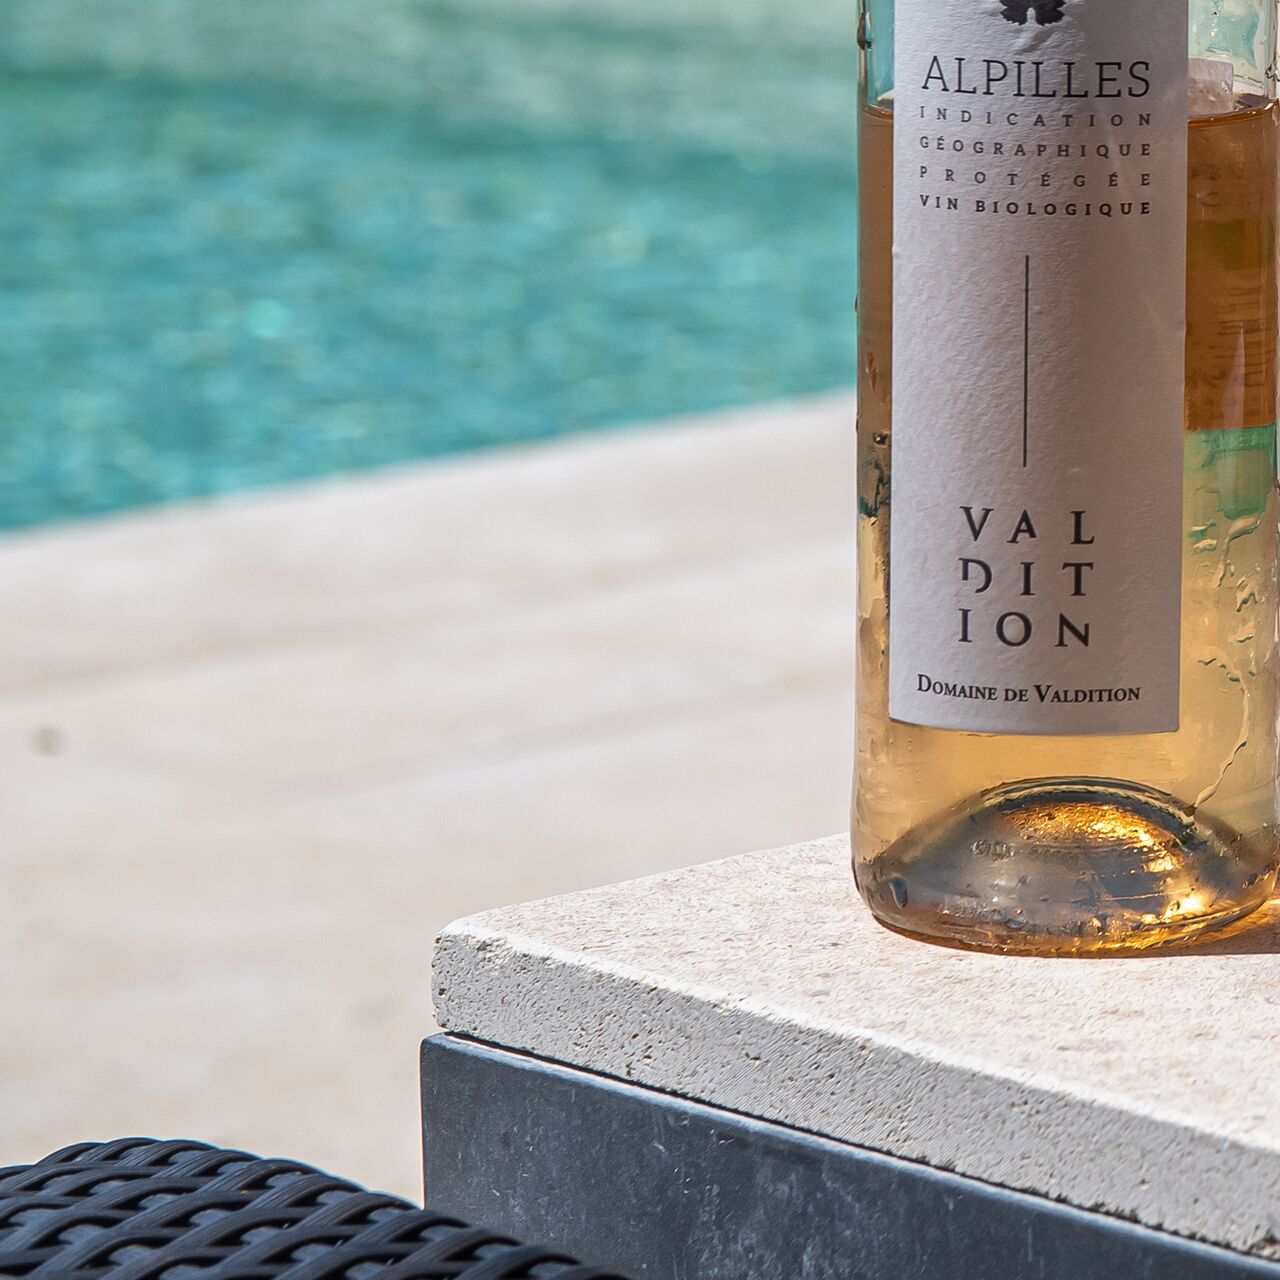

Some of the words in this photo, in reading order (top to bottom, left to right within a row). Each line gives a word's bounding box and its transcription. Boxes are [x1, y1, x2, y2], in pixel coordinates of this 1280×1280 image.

[921, 55, 1151, 99] ALPILLES
[919, 106, 1151, 126] INDICATION
[919, 135, 1151, 158] GÉOGRAPHIQUE
[919, 165, 1151, 187] PROTÉGÉE
[919, 194, 958, 210] VIN
[975, 200, 1151, 216] BIOLOGIQUE
[959, 505, 1095, 545] VAL
[958, 558, 1094, 597] DIT
[958, 608, 1090, 648] ION
